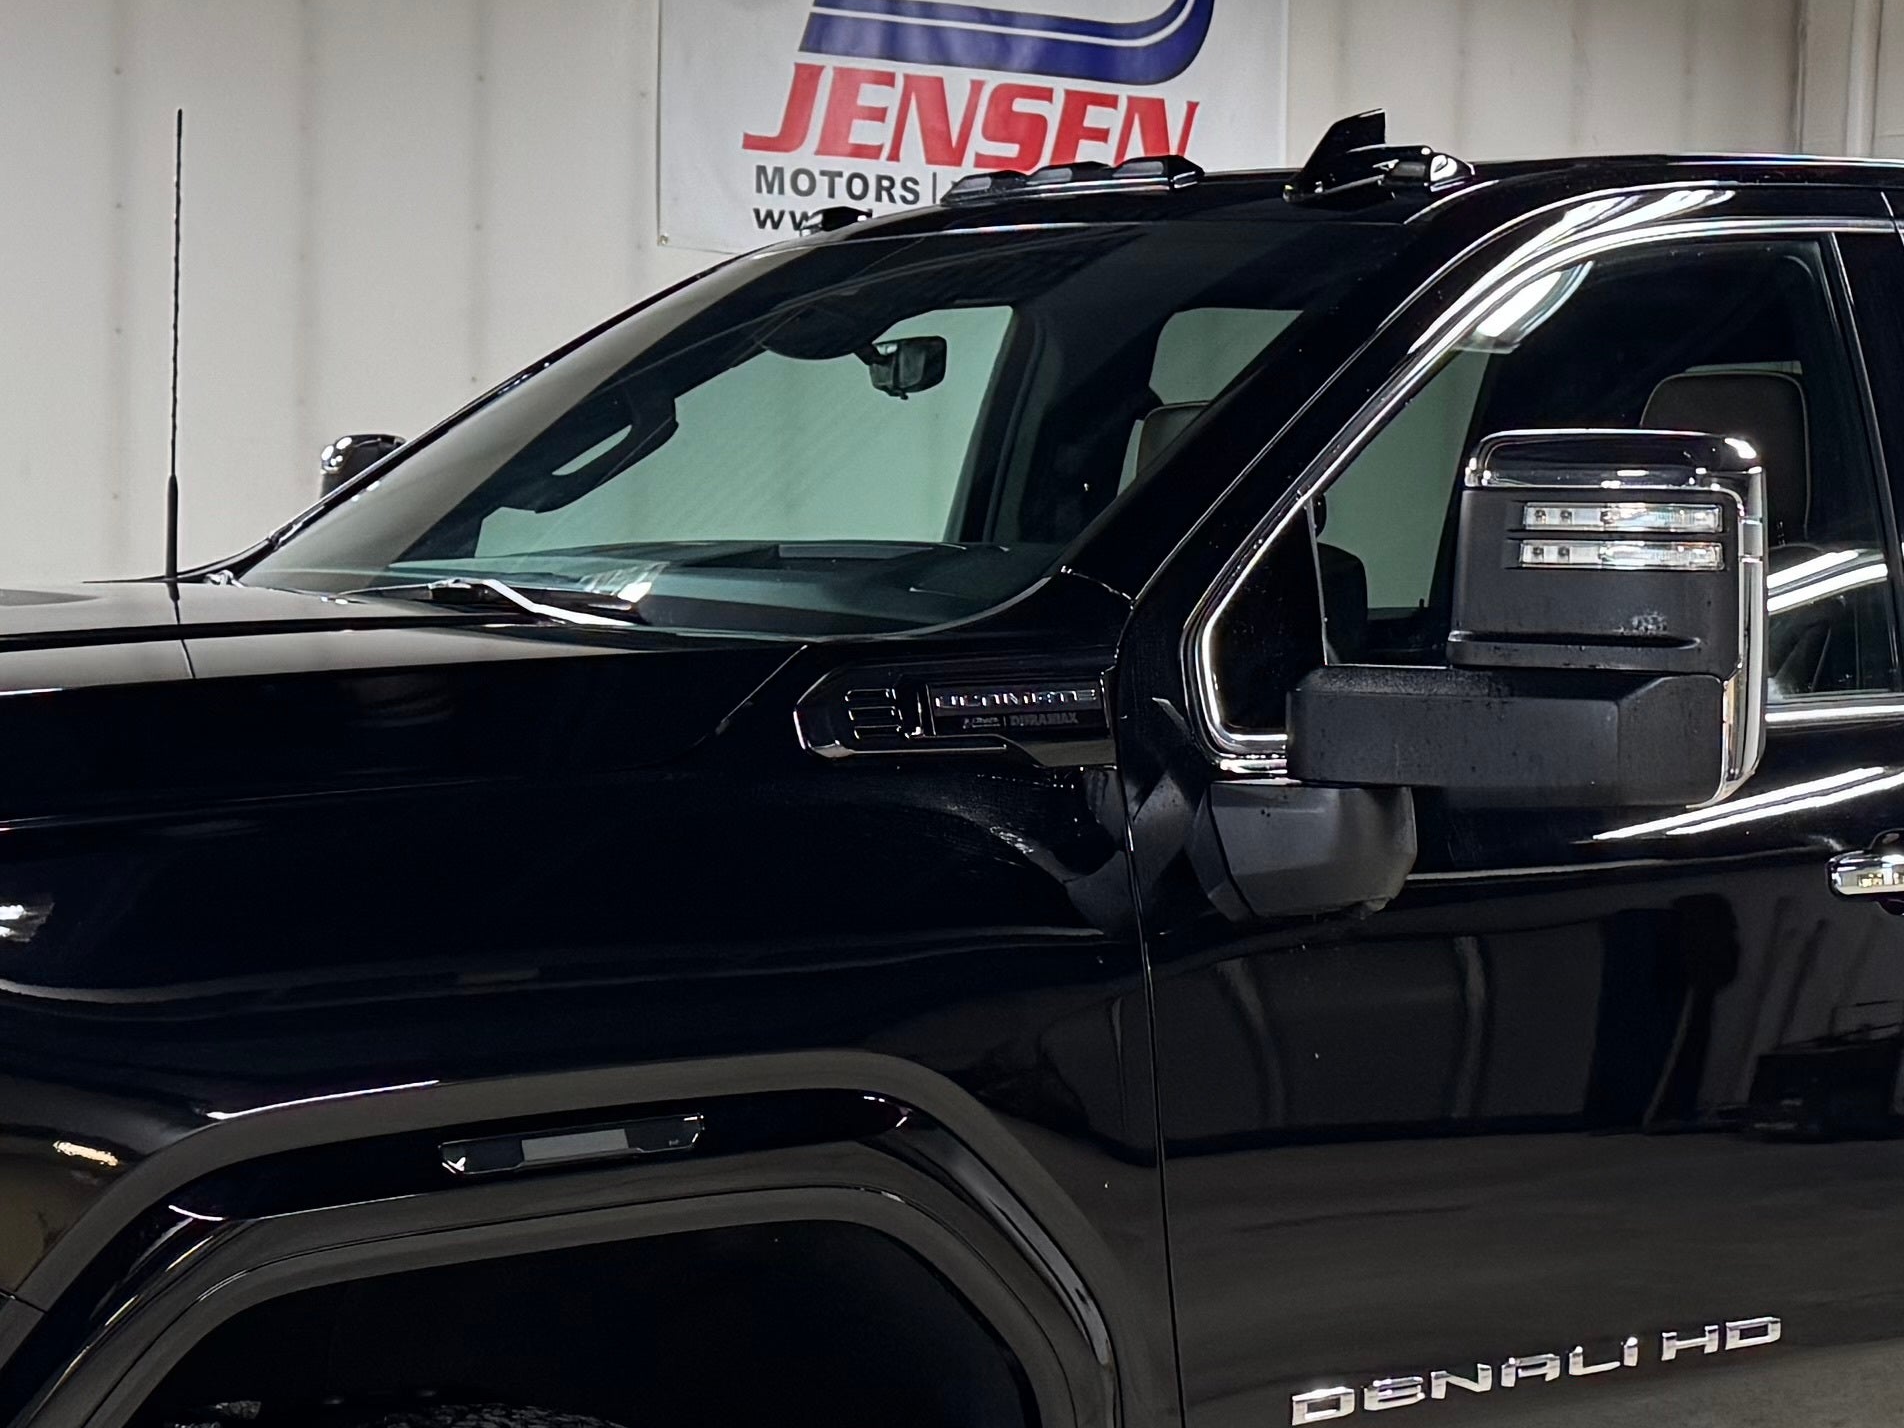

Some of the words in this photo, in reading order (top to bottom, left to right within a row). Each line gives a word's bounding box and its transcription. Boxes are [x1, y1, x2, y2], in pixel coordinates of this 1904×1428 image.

[741, 62, 1200, 174] JENSEN
[754, 164, 921, 206] MOTORS
[1291, 1337, 1639, 1426] DENALI
[1661, 1315, 1782, 1362] HD
